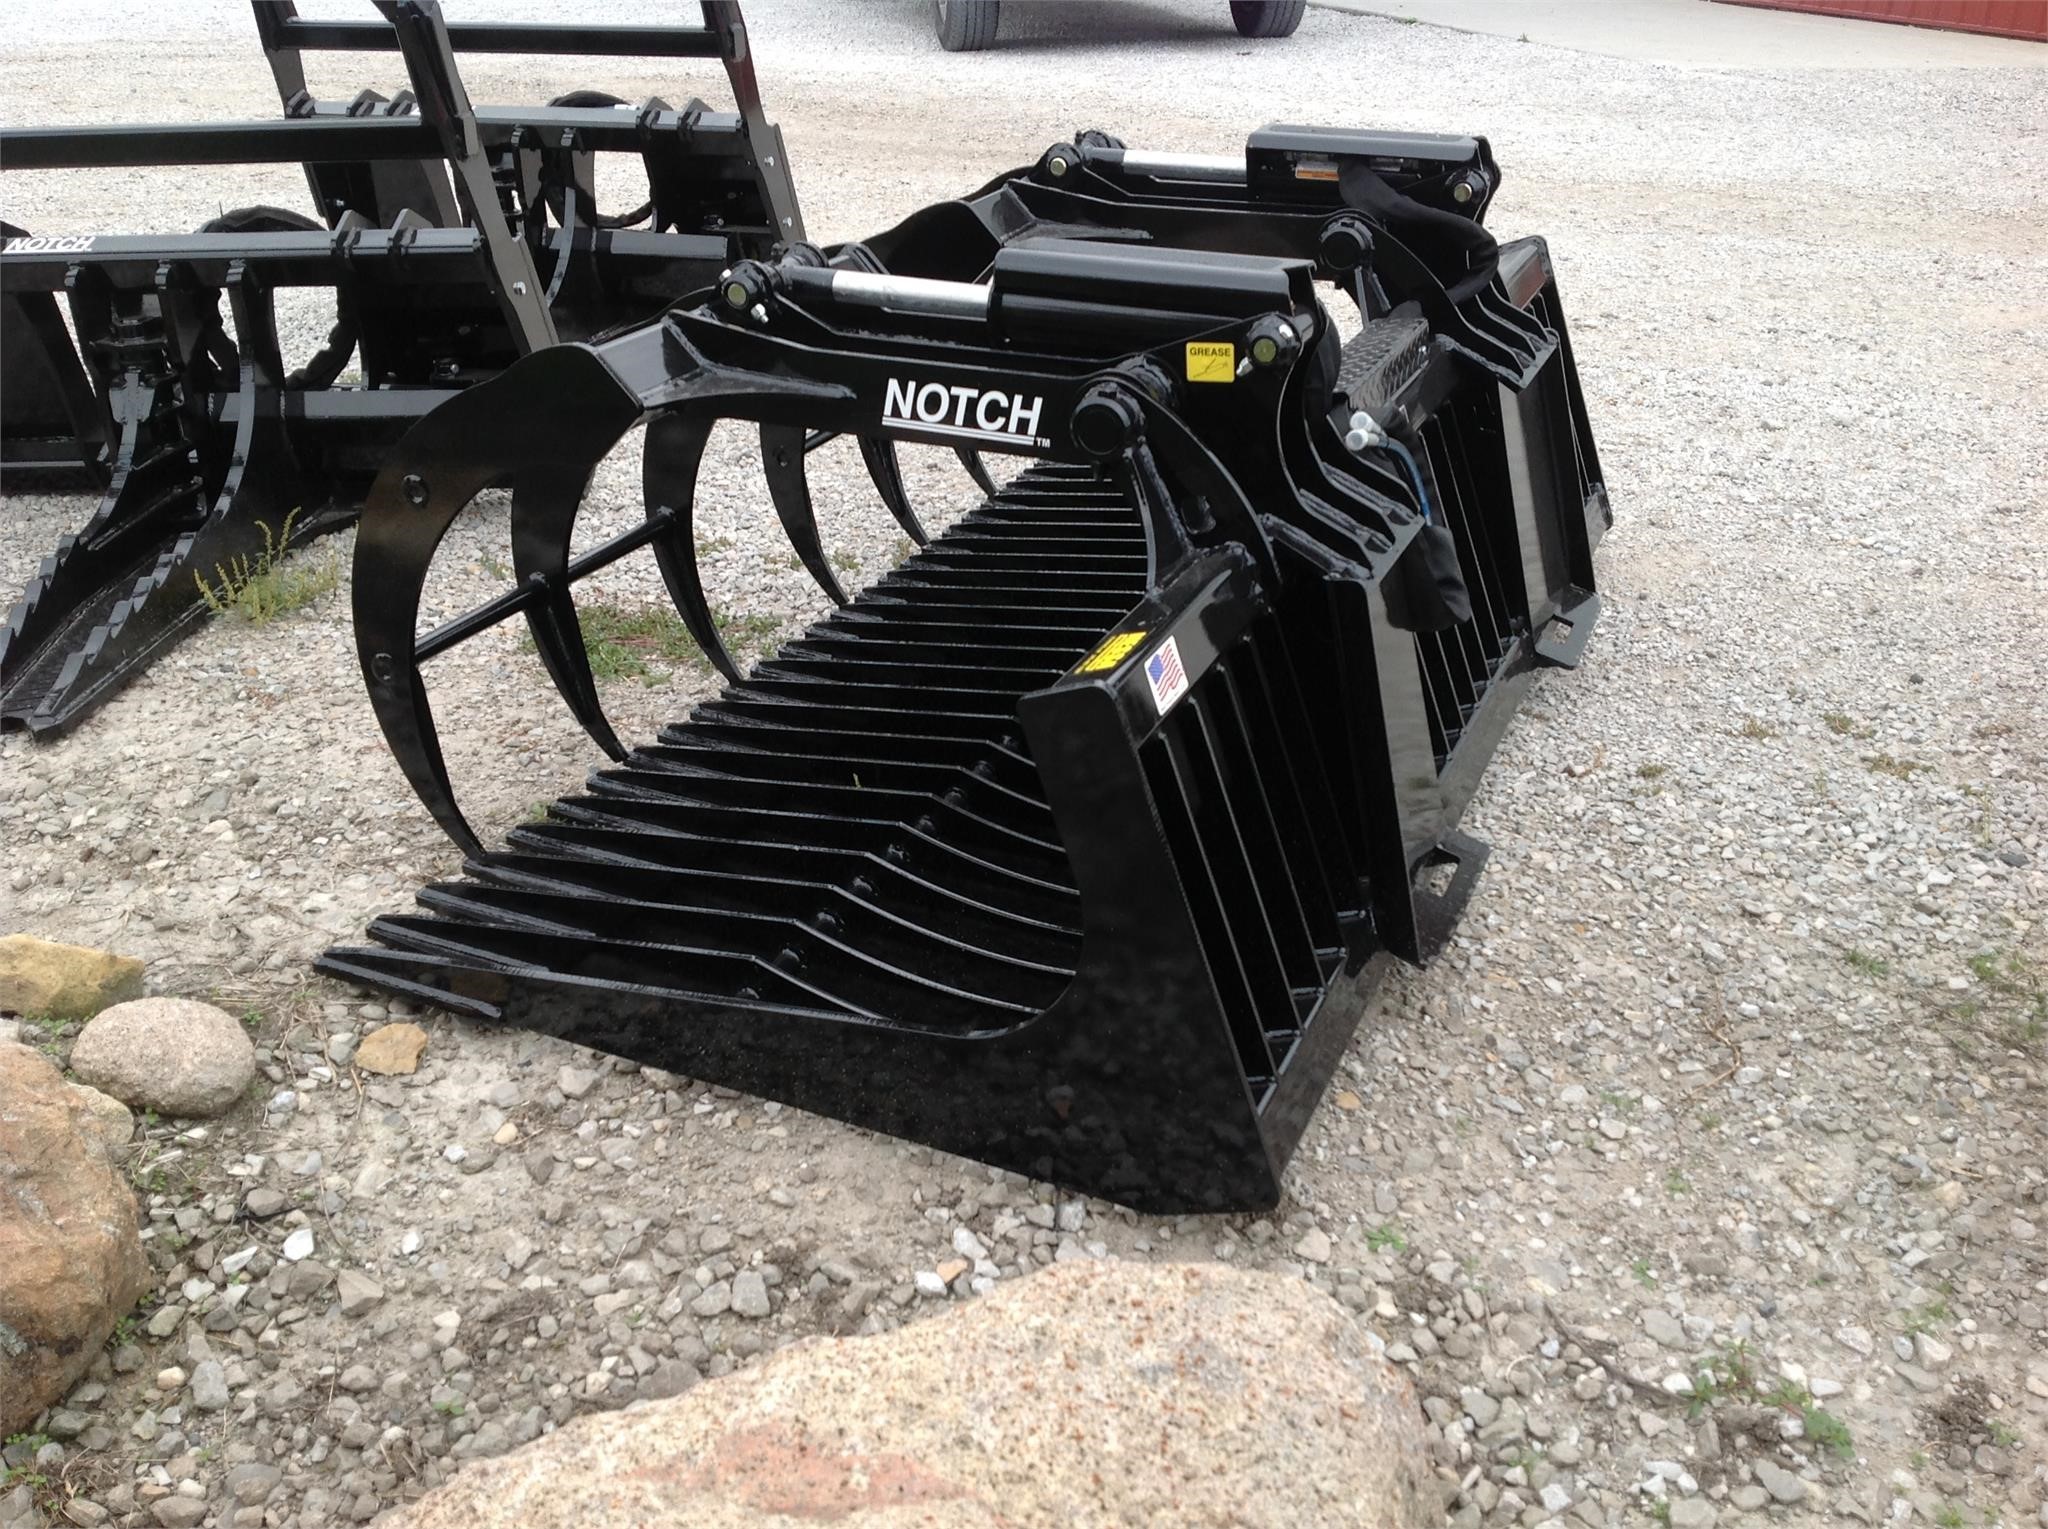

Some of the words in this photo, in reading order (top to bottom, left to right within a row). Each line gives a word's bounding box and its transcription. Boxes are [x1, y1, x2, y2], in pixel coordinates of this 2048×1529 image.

[3, 236, 96, 252] NOTCH
[1189, 346, 1232, 357] GREASE
[883, 378, 1043, 437] NOTCH
